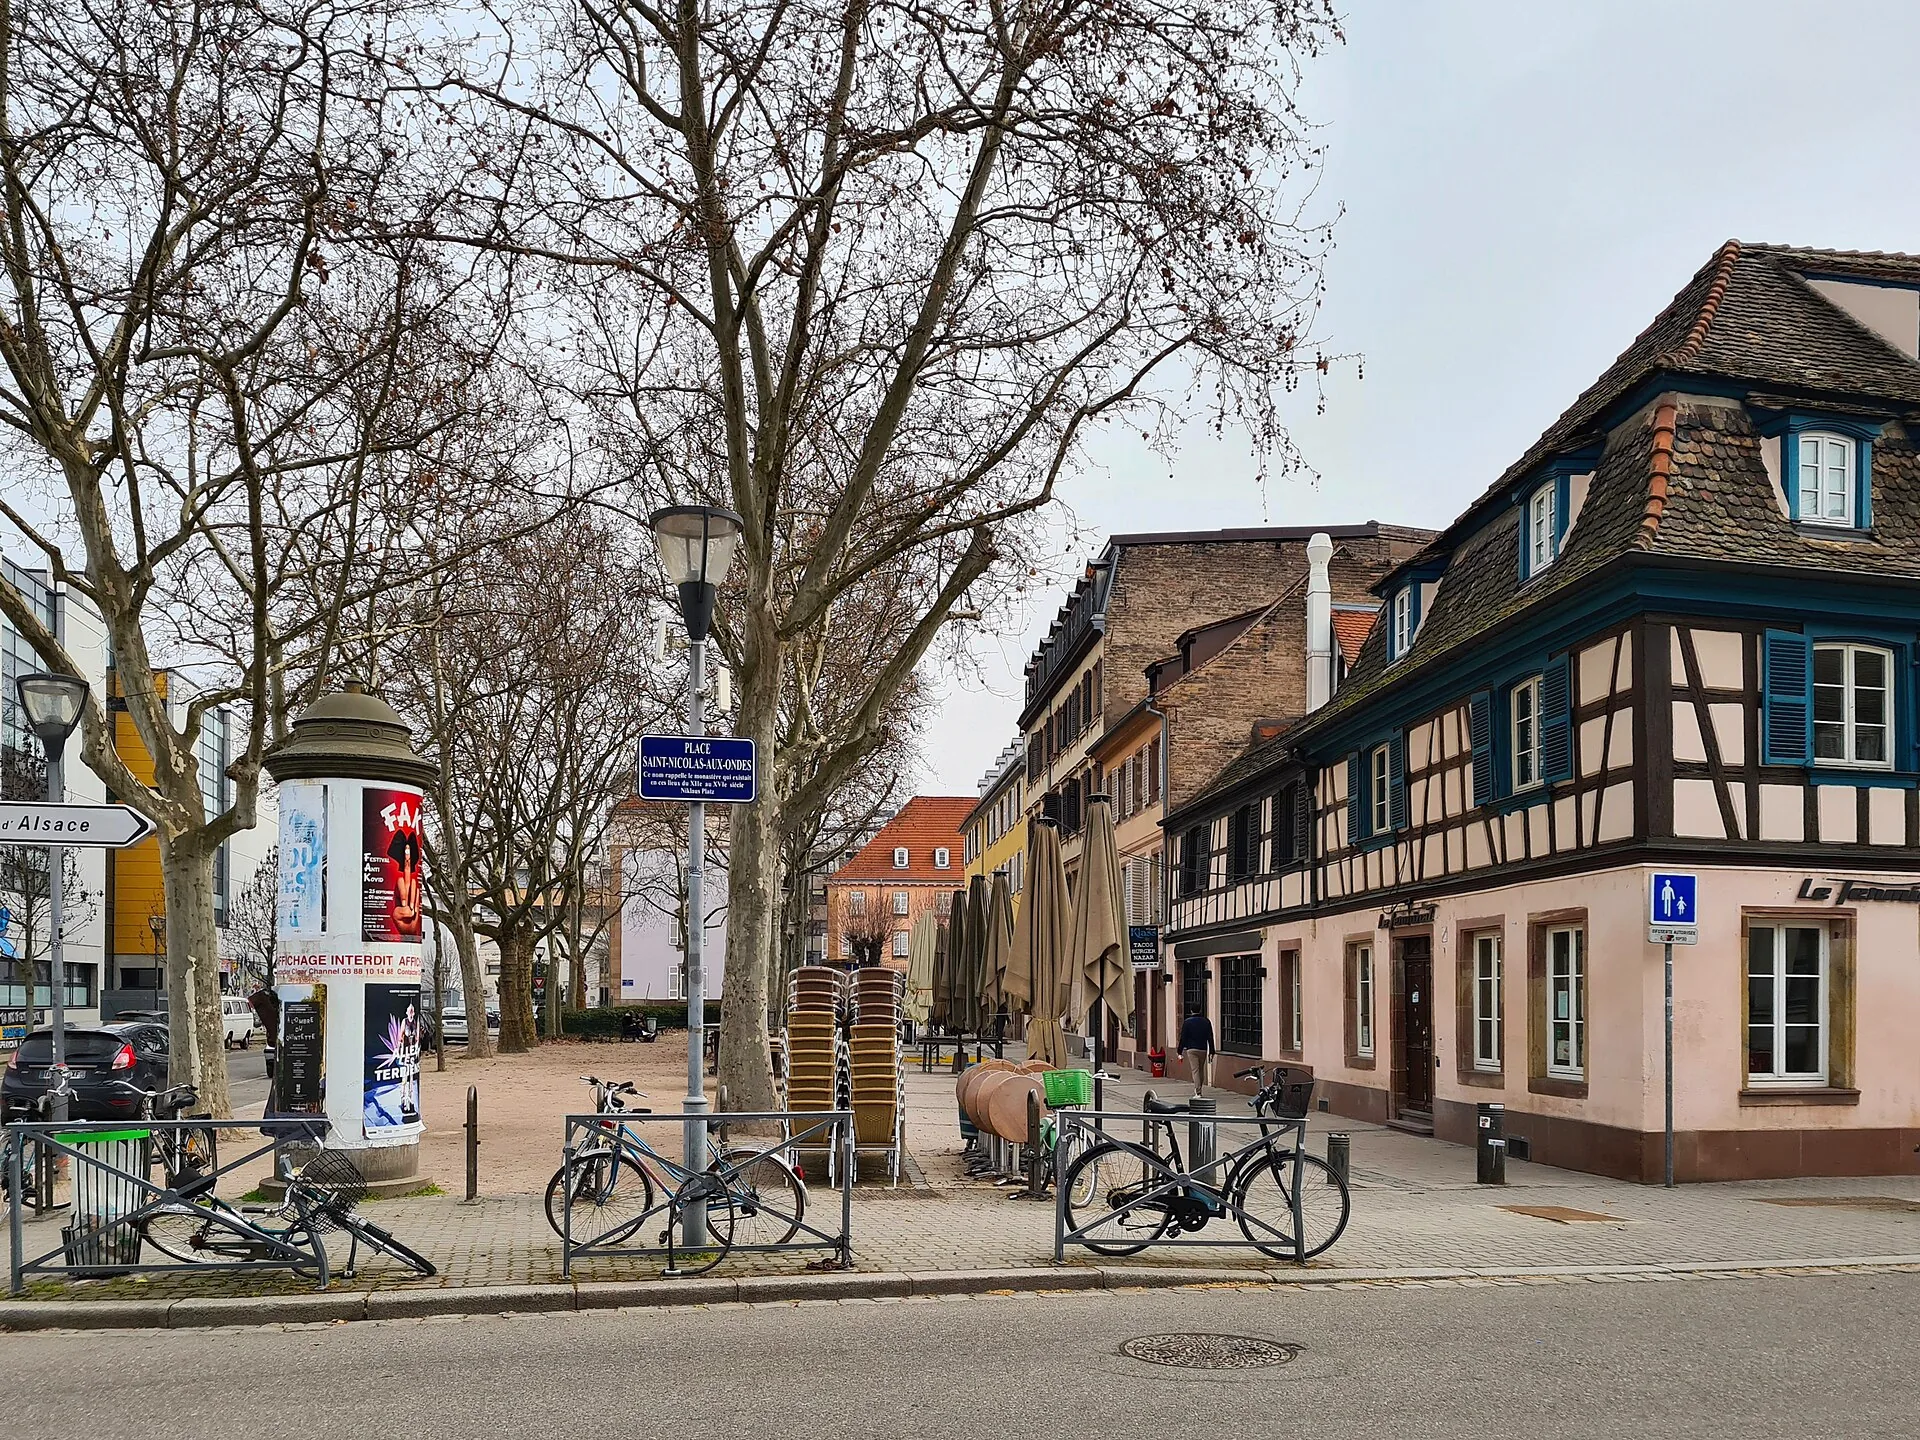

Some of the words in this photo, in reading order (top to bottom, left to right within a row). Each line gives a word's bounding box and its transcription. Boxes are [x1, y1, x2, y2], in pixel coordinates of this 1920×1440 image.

[684, 742, 711, 754] PLACE
[642, 755, 752, 771] SAINT-NICOLAS-AUX-ONDES
[665, 772, 687, 780] rappelle
[694, 772, 721, 780] monastère
[701, 787, 715, 795] Platz
[18, 815, 90, 832] Alsace
[1797, 878, 1832, 900] Le
[331, 955, 394, 966] INTERDIT
